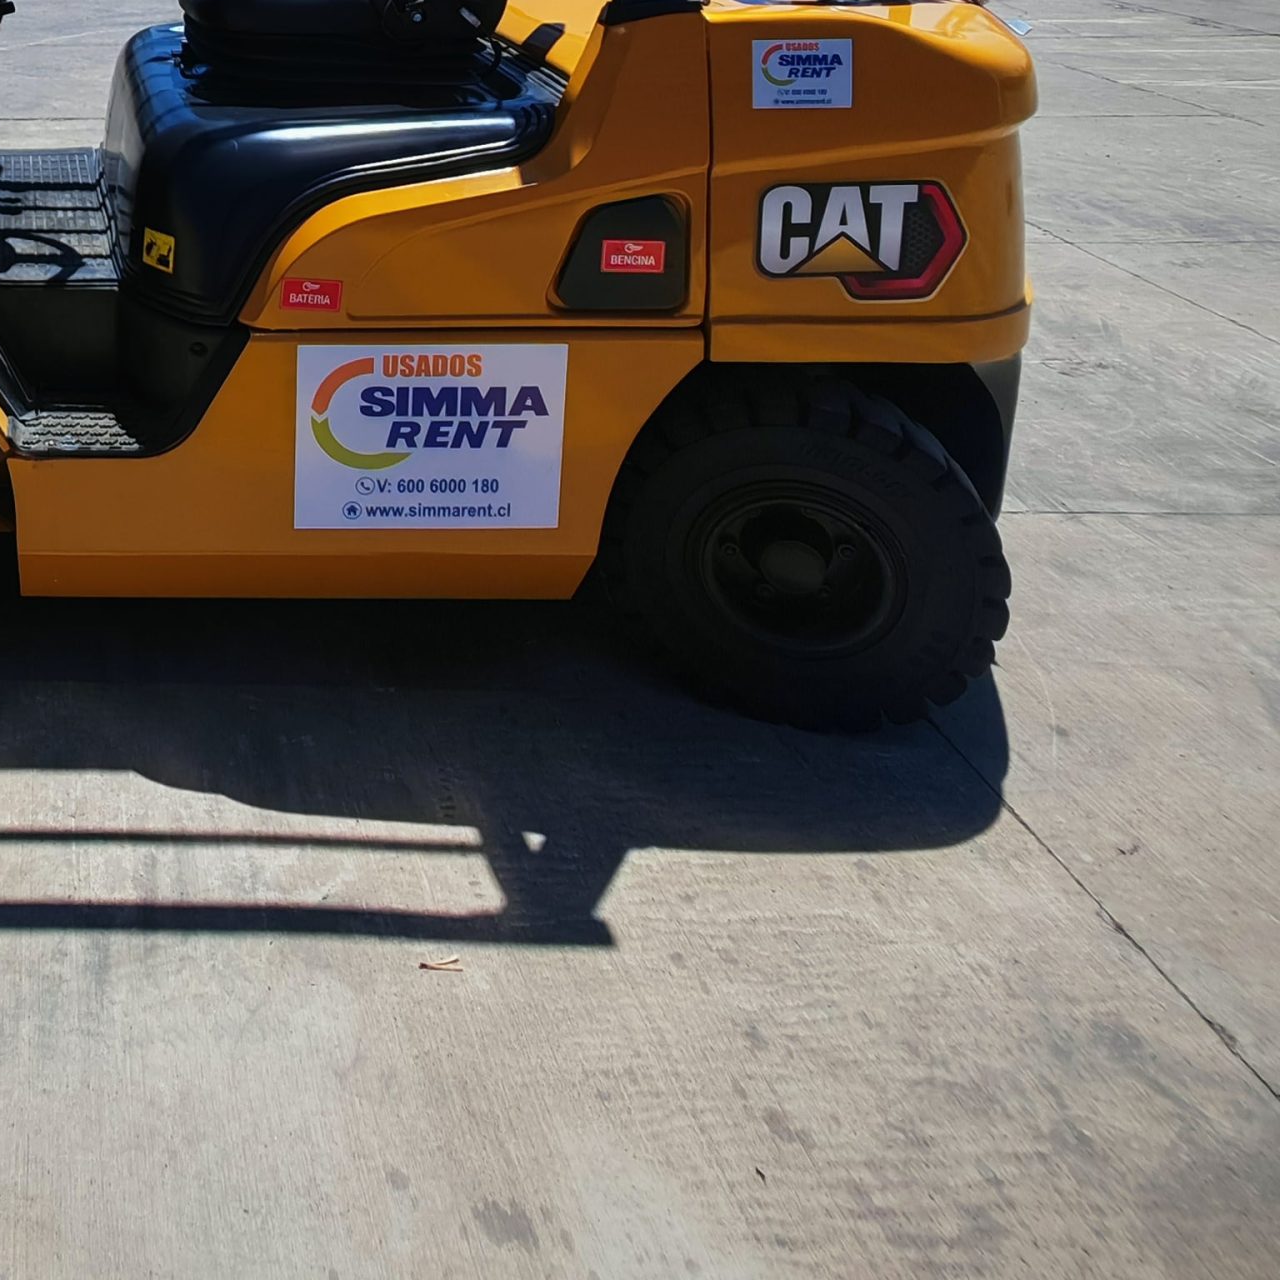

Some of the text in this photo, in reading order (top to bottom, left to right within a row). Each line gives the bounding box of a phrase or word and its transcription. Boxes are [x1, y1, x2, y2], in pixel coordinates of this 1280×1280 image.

[778, 53, 843, 67] SIMMA
[787, 66, 837, 78] RENT
[759, 183, 919, 274] CAT
[610, 254, 656, 266] BENCINA
[289, 292, 331, 305] BATERIA
[382, 354, 483, 378] USADOS
[359, 386, 550, 418] SIMMA
[385, 420, 528, 449] RENT
[376, 478, 500, 494] V: 600 6000 180
[365, 502, 512, 518] www.simmarent.cl
